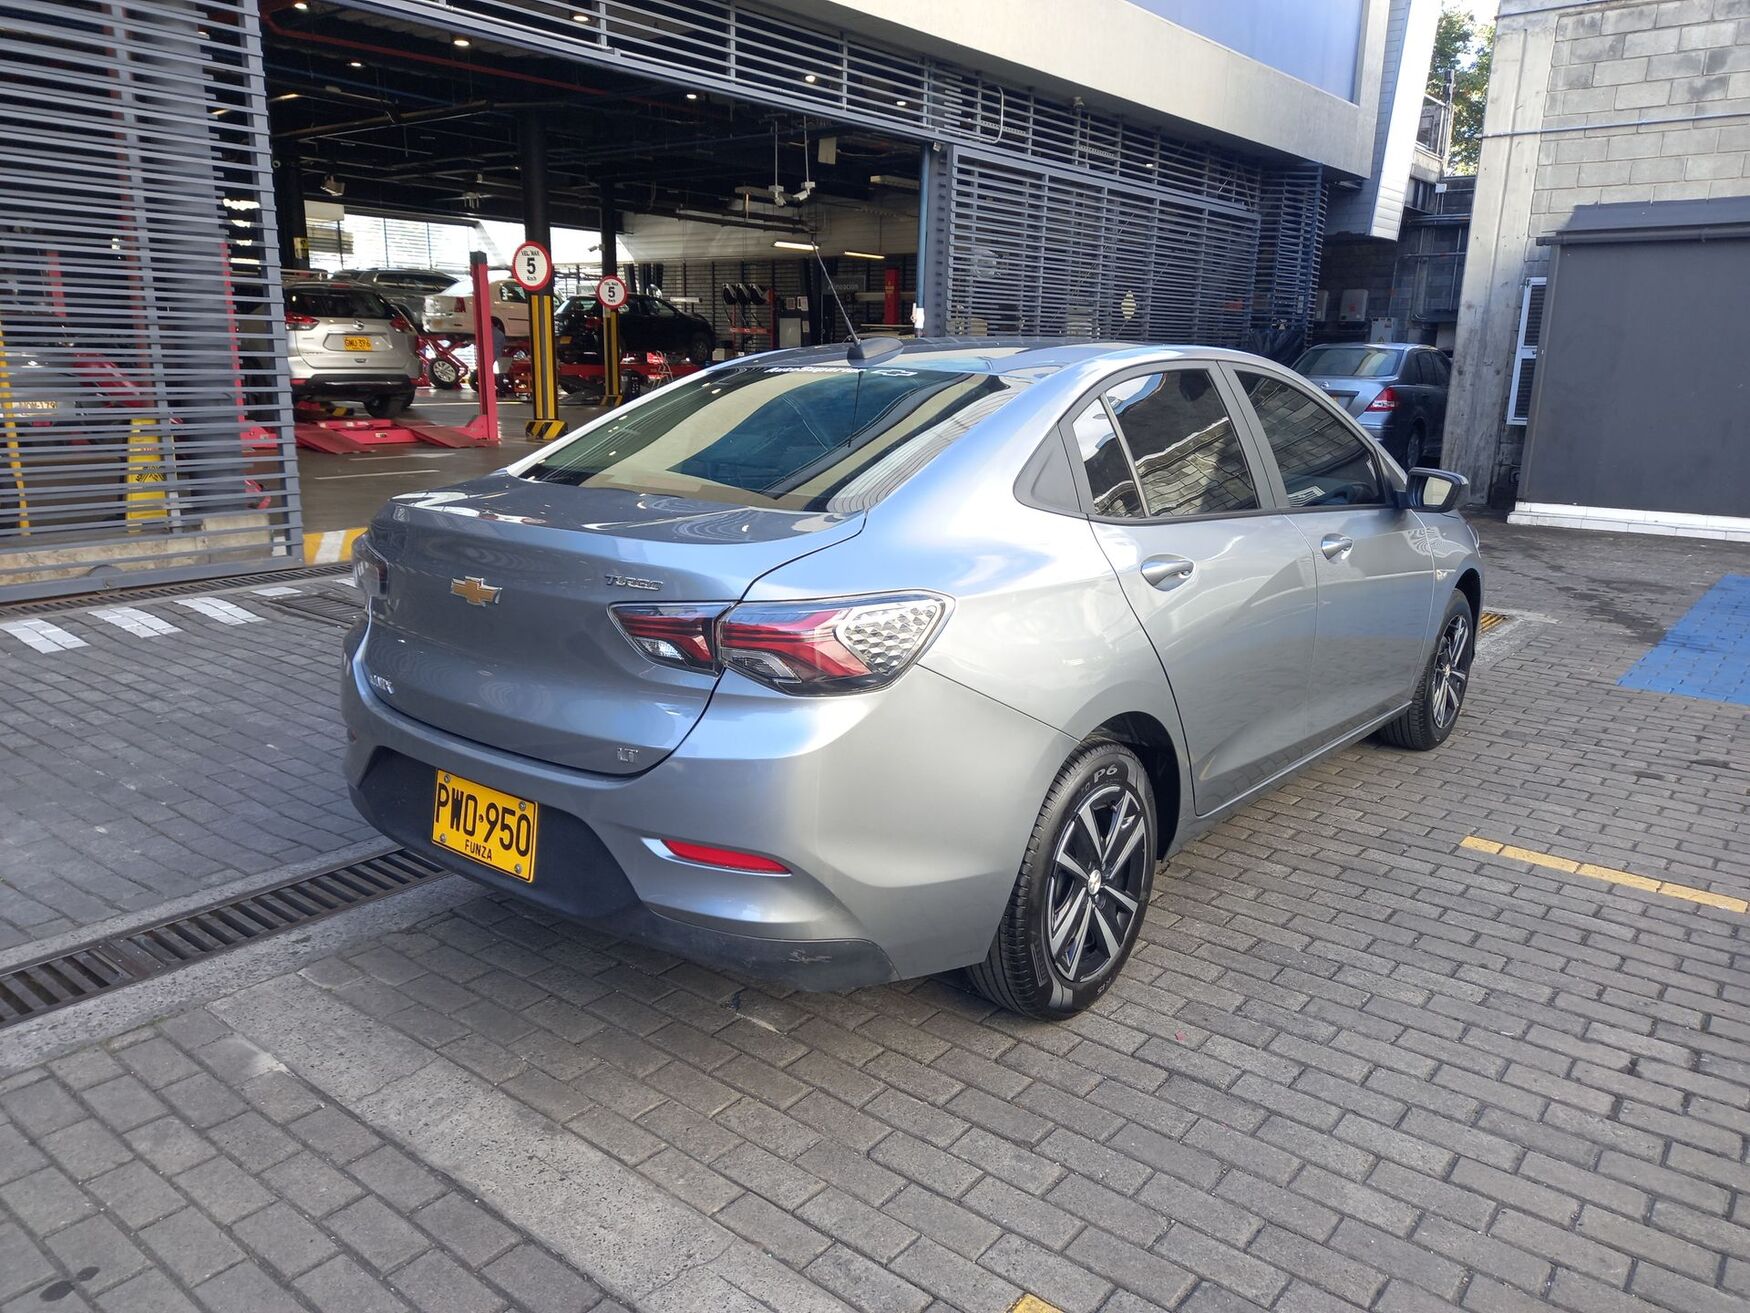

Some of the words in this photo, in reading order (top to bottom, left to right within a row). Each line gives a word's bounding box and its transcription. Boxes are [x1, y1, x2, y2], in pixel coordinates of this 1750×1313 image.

[526, 257, 536, 275] 5
[608, 286, 616, 298] 5
[617, 747, 639, 763] LT
[1094, 763, 1118, 783] P6
[464, 839, 493, 861] FUNZA
